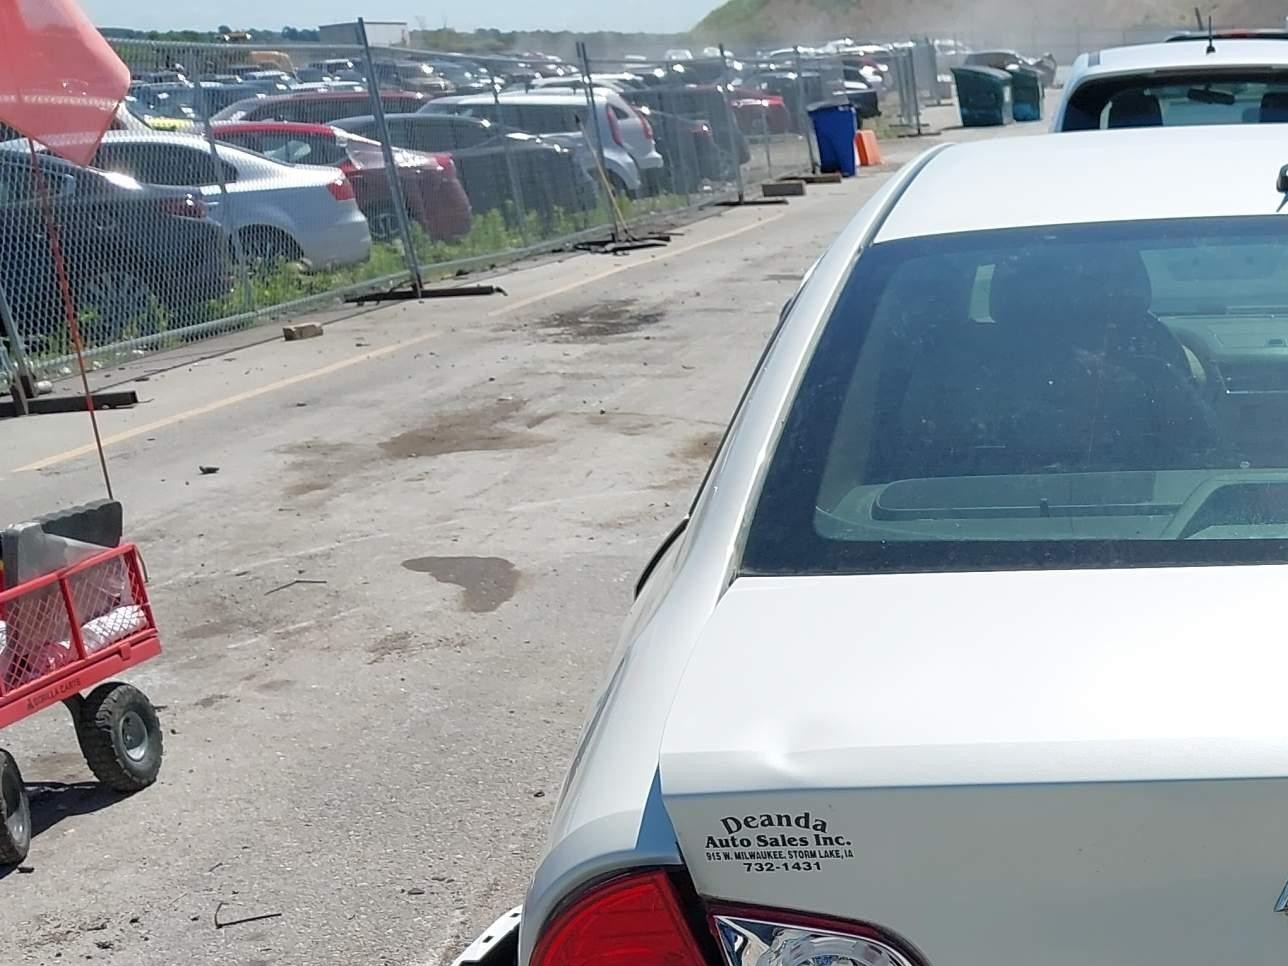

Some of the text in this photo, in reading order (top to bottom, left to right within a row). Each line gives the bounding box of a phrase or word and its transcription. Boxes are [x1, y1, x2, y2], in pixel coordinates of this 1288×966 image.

[720, 812, 828, 835] Deanda
[705, 833, 852, 849] Auto Sales Inc.
[706, 852, 722, 861] 915
[723, 851, 733, 861] W.
[787, 849, 817, 860] STORM
[818, 849, 844, 860] LAKE,
[844, 849, 855, 859] IA
[743, 861, 821, 872] 732-1431
